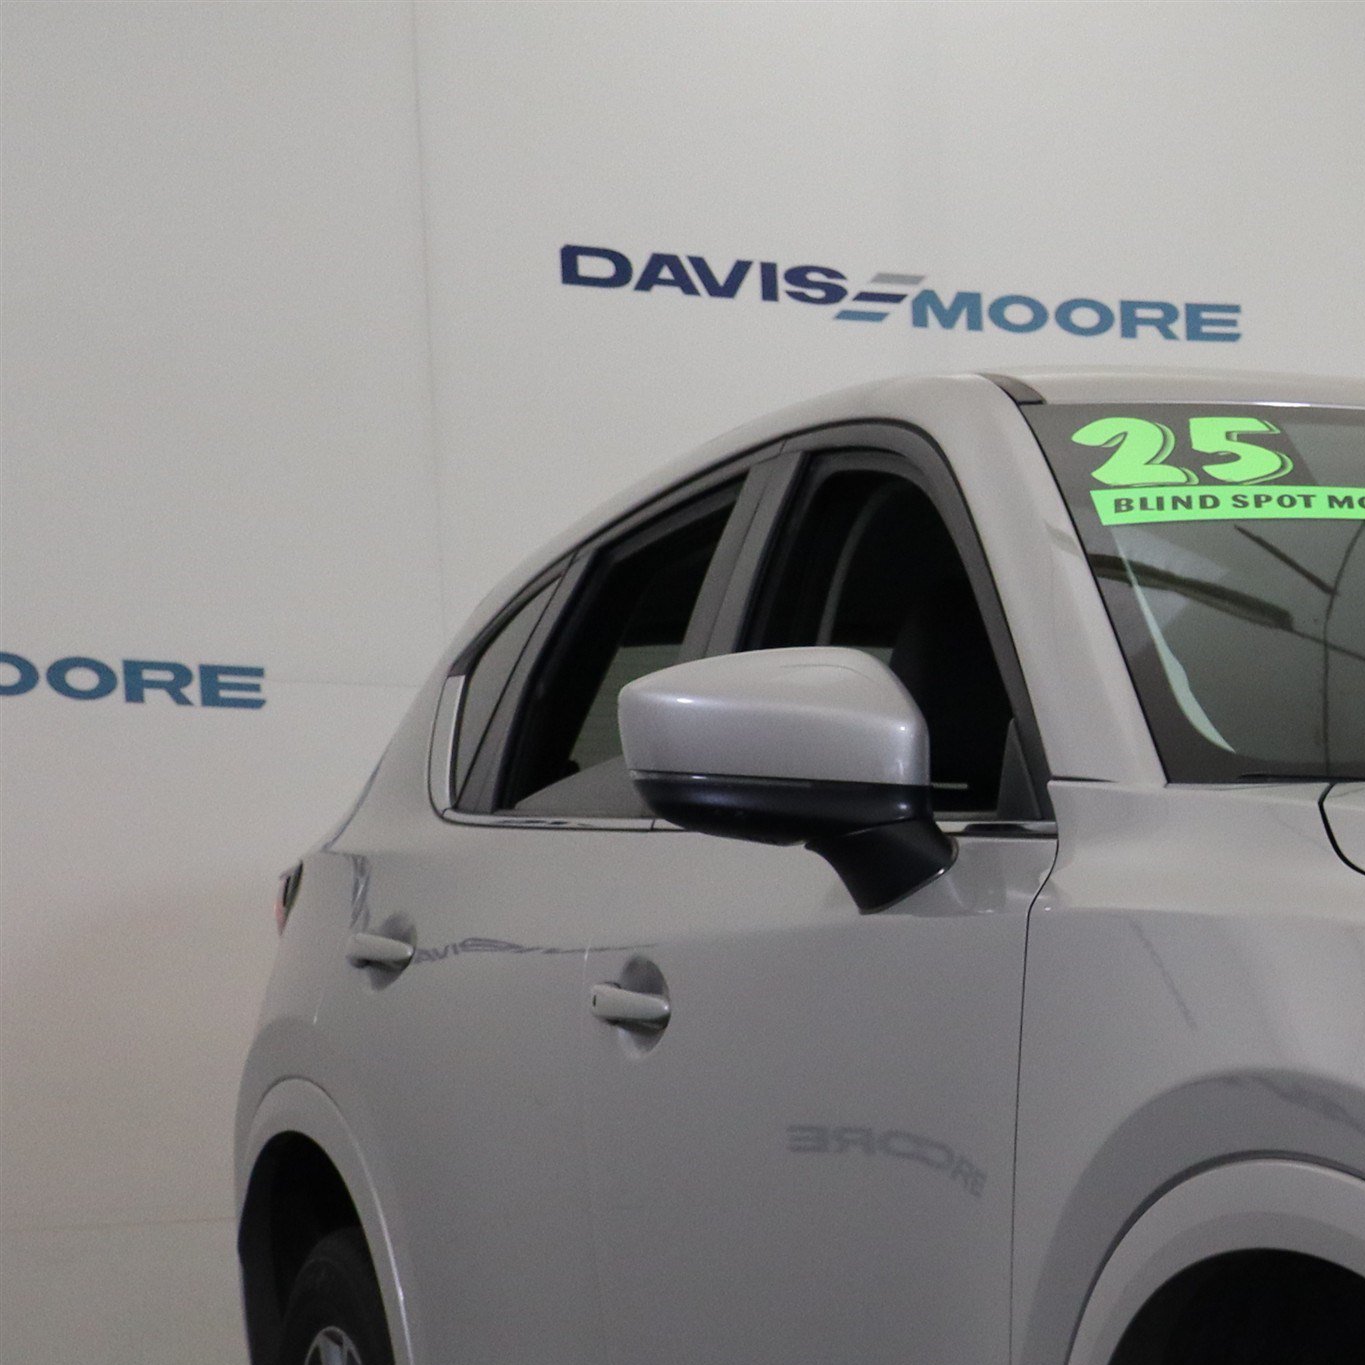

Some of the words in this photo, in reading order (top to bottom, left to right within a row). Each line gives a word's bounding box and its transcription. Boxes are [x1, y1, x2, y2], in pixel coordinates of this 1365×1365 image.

[560, 244, 849, 305] DAVIS
[911, 289, 1243, 342] MOORE
[1071, 417, 1294, 487] 25
[1114, 494, 1221, 514] BLIND
[1232, 494, 1317, 510] SPOT
